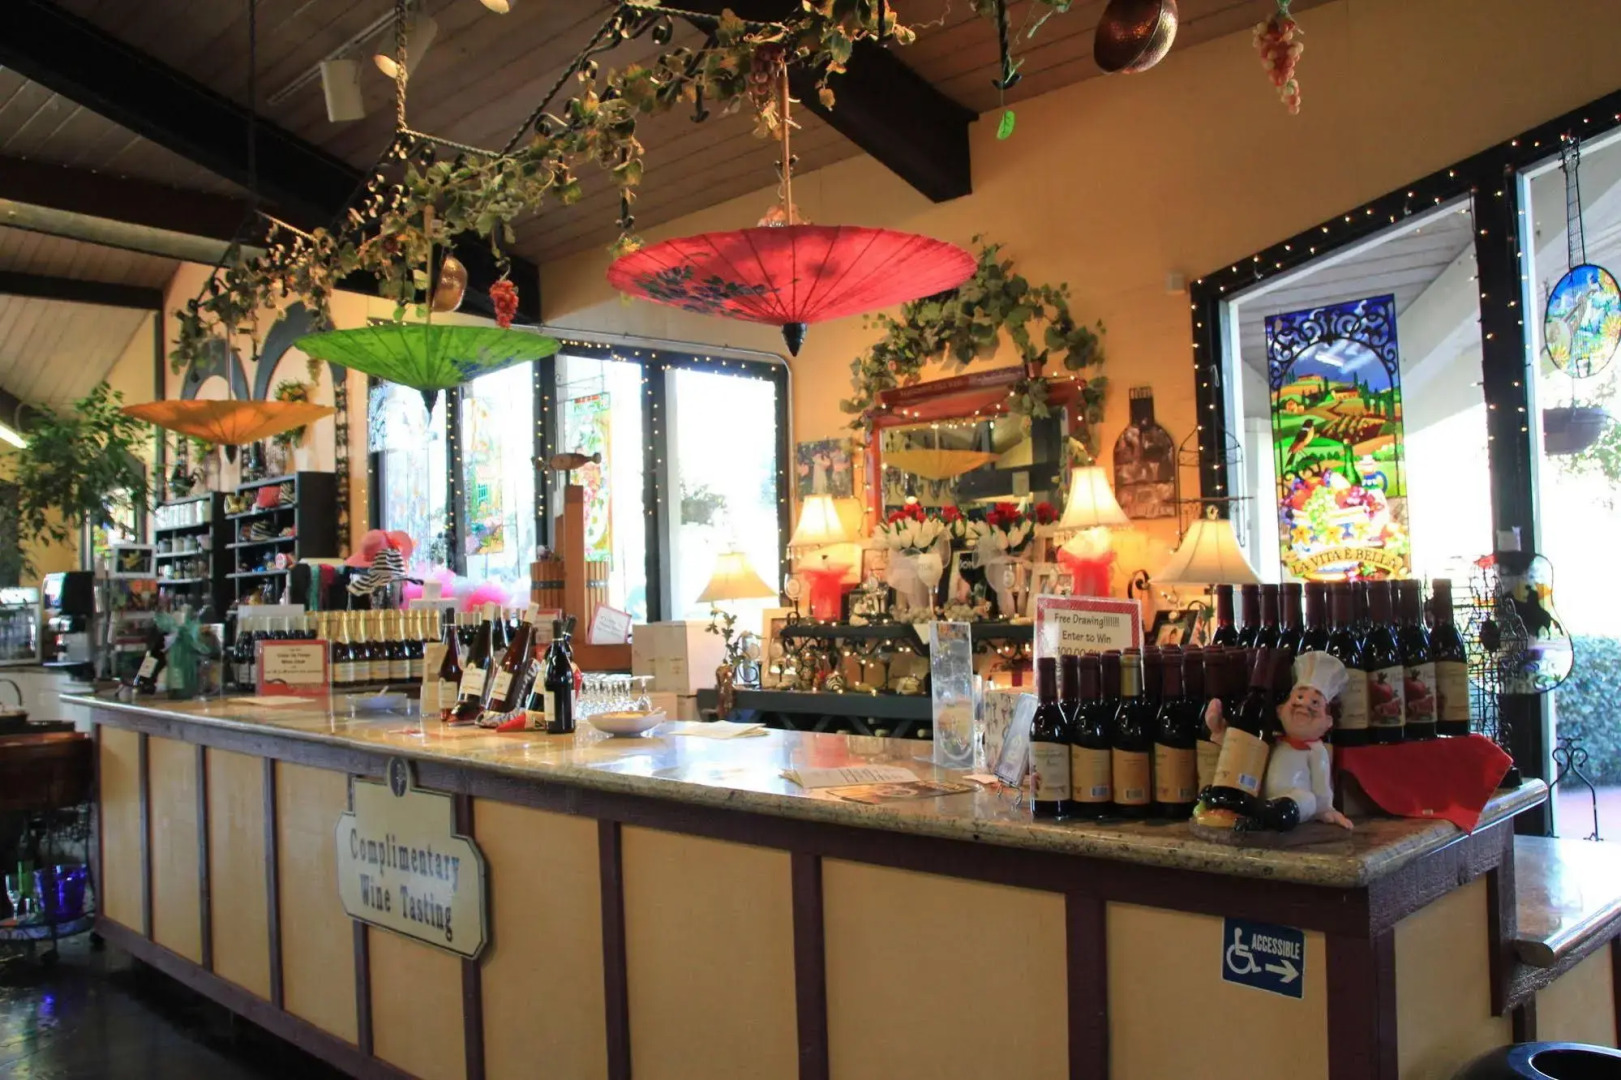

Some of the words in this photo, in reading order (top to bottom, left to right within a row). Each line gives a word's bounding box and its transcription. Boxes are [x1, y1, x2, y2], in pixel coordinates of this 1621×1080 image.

[1292, 562, 1309, 574] LA
[1310, 551, 1341, 567] VITA
[1356, 548, 1397, 568] BELLA
[1054, 613, 1071, 624] Free
[1062, 630, 1084, 641] Enter
[1086, 634, 1095, 643] to
[1096, 633, 1112, 644] Win
[350, 828, 460, 893] Complimentary
[360, 873, 391, 912] Wine
[400, 884, 453, 942] Tasting
[1251, 933, 1300, 960] ACCESSIBLE
